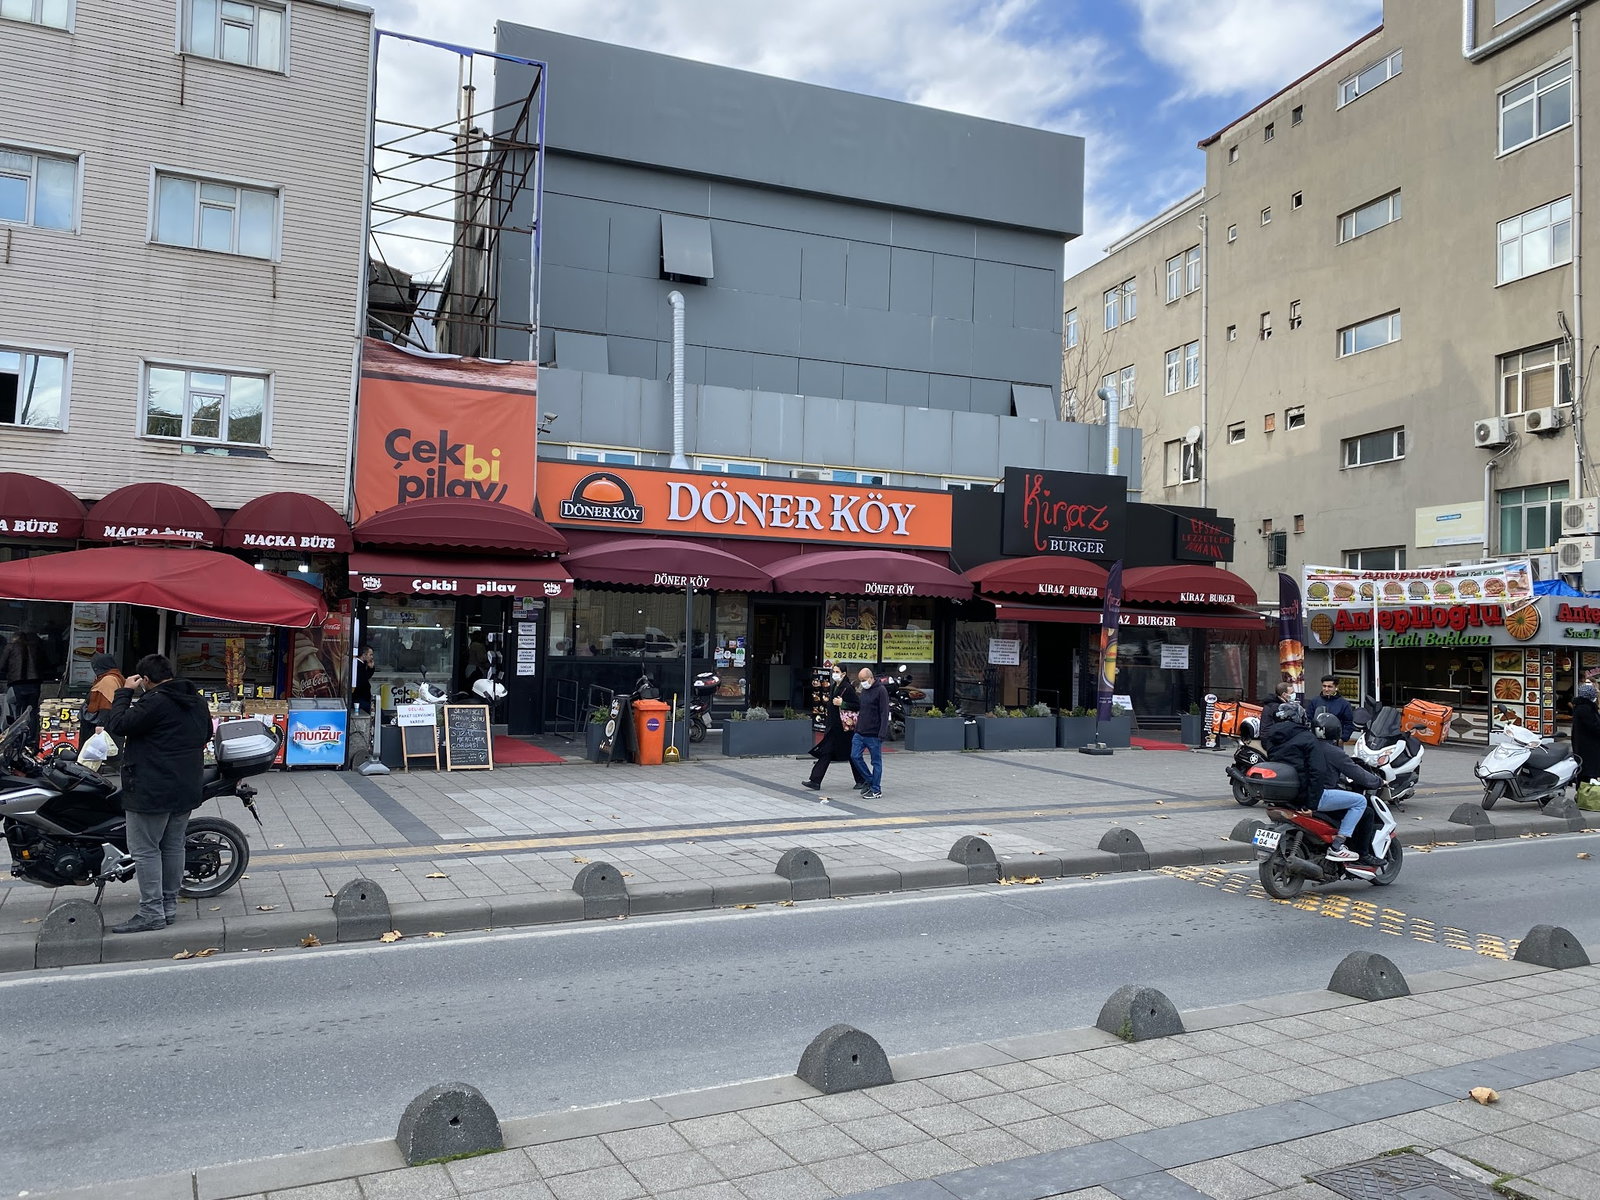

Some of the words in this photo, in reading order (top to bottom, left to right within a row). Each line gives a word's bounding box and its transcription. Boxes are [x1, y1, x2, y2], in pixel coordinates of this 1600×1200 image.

[564, 503, 612, 518] DÖNER
[613, 506, 640, 520] KÖY
[666, 480, 824, 530] DÖNER
[830, 492, 916, 536] KÖY
[13, 519, 58, 533] BÜFE
[243, 534, 297, 547] MACKA
[300, 535, 336, 549] BÜFE
[1050, 540, 1104, 554] BURGER
[654, 572, 687, 586] DÖNER
[689, 575, 710, 587] KÖY
[412, 579, 458, 592] Çekbi
[476, 581, 516, 594] pilav
[865, 582, 895, 594] DÖNER
[897, 583, 915, 594] KÖY
[1069, 585, 1098, 597] BURGER
[1209, 593, 1236, 603] BURGER
[1138, 616, 1176, 627] BURGER
[1334, 603, 1504, 633] Anteplioğlu
[825, 632, 850, 640] PAKET
[1387, 633, 1420, 647] Tatlı
[1425, 631, 1491, 646] Baklava
[833, 651, 847, 659] 282
[848, 651, 857, 659] 82
[858, 652, 868, 660] 42
[61, 708, 70, 720] 5
[42, 718, 51, 729] 5
[295, 731, 341, 742] munzur
